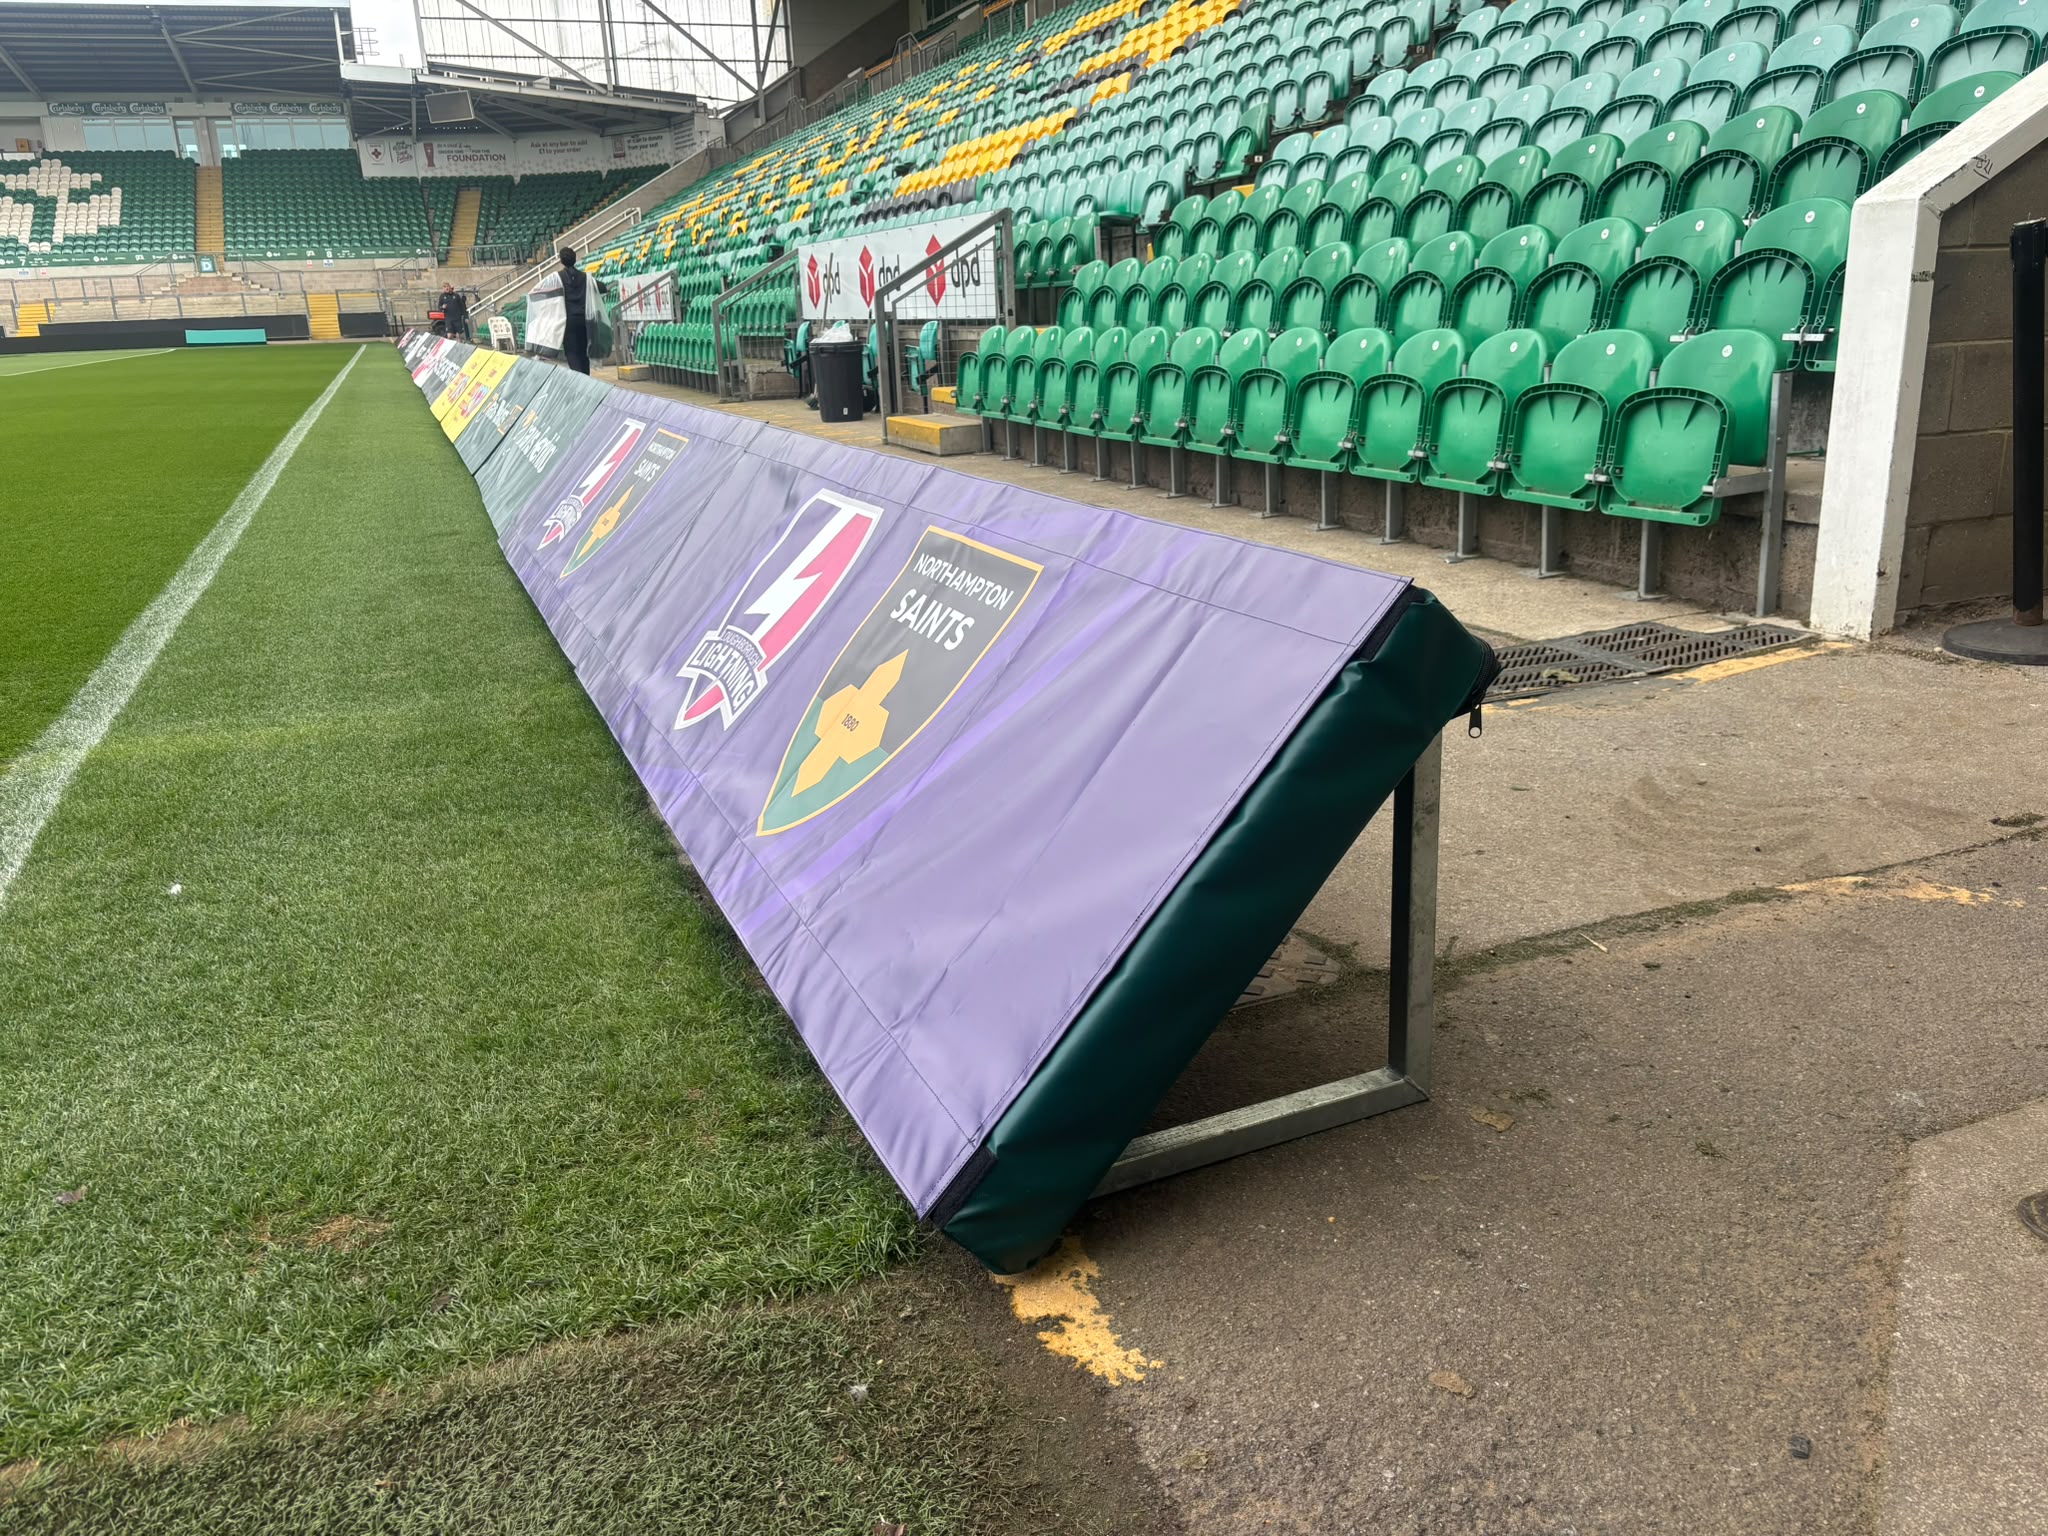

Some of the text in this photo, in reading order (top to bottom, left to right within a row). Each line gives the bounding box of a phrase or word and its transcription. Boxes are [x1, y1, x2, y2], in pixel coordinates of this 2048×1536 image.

[49, 102, 85, 115] Carlsberg
[91, 102, 127, 115] Carlsberg
[129, 102, 165, 115] Carlsberg
[233, 102, 267, 114] Carlsberg
[269, 102, 303, 114] Carlsberg
[308, 102, 342, 114] Carlsberg
[446, 153, 507, 162] FOUNDATION
[203, 263, 212, 271] D
[950, 243, 981, 299] dpd
[822, 260, 842, 304] dpd
[912, 552, 1015, 611] NORTHAMPTON
[889, 588, 976, 651] SAINTS
[720, 630, 761, 668] LOUGHBOROUGH
[690, 641, 756, 711] LIGHTNING
[841, 713, 860, 732] 1880
